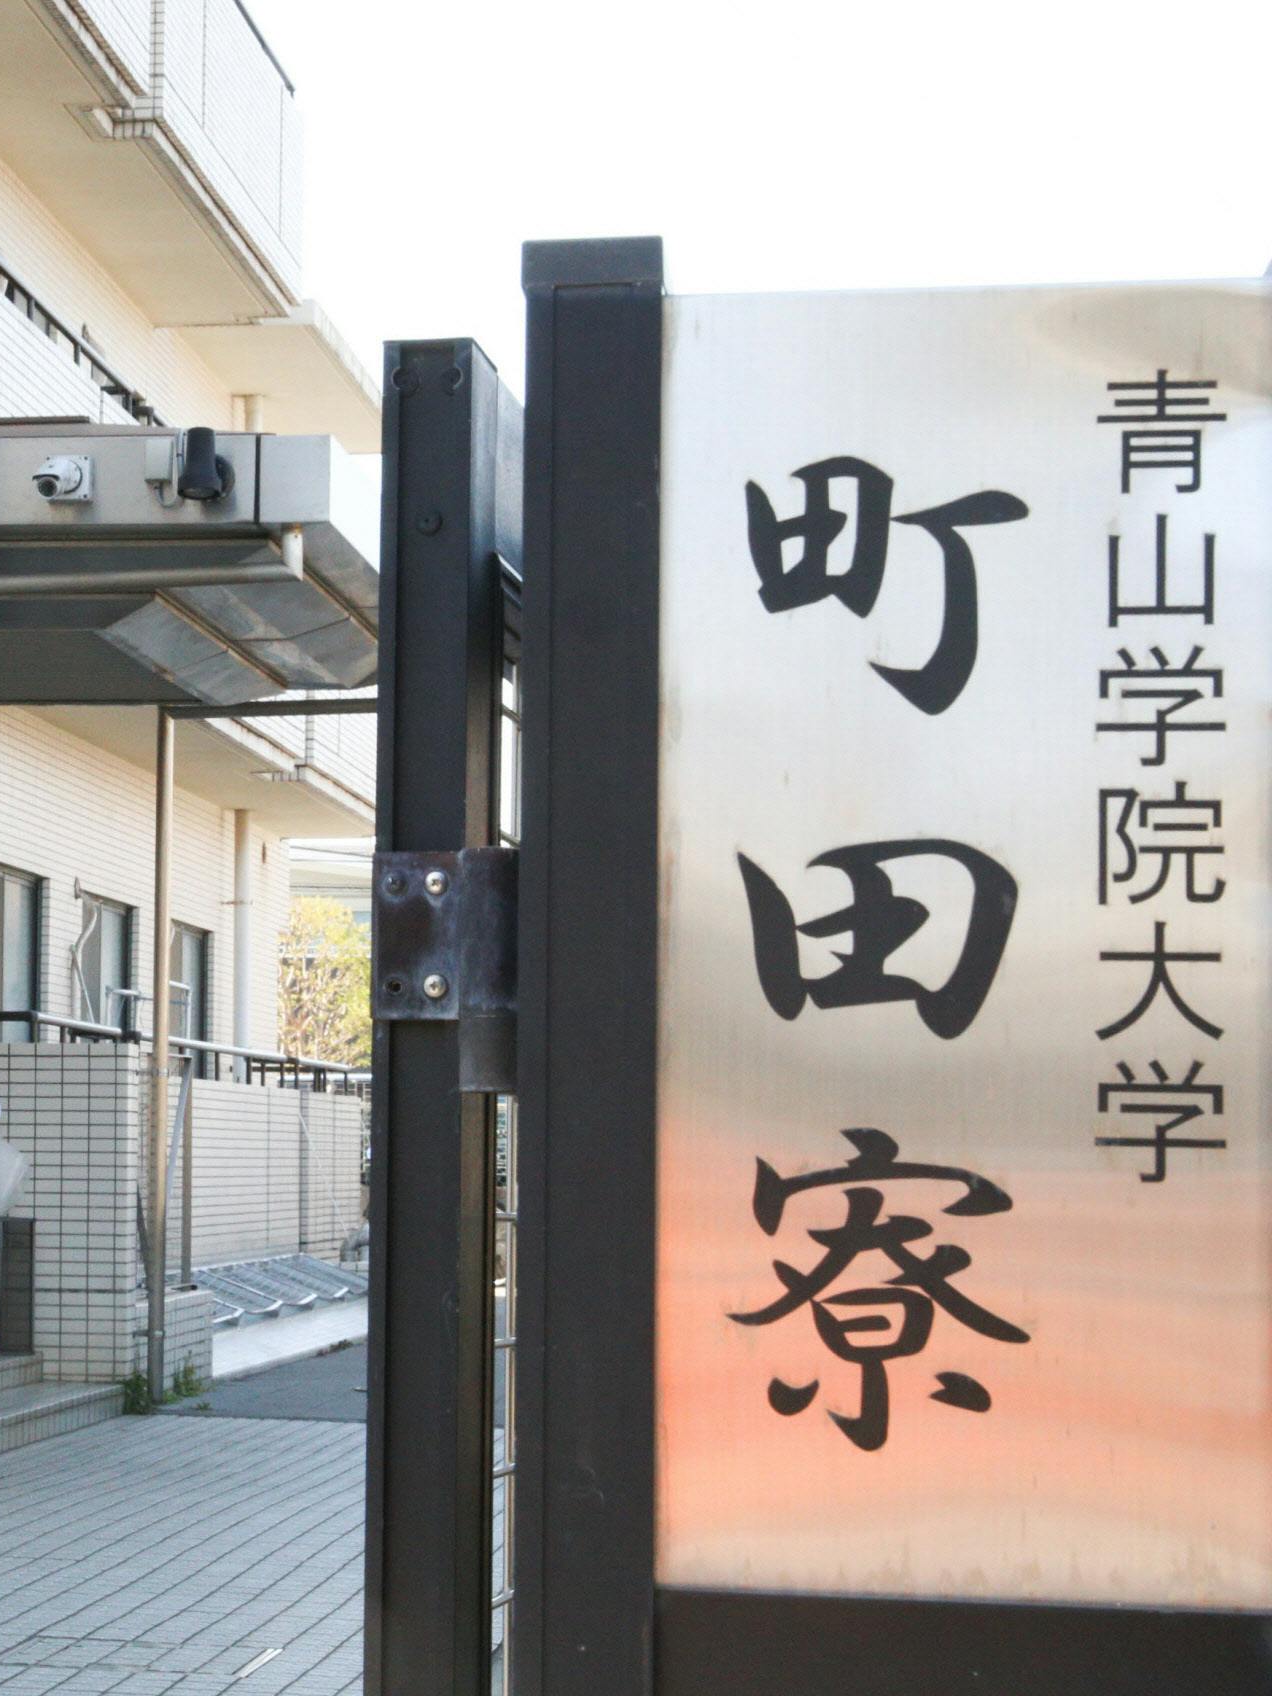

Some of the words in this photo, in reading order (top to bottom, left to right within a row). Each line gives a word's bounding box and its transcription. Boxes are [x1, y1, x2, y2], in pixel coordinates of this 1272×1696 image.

[729, 455, 1030, 1452] 町田寮
[1095, 369, 1227, 1183] 青山学院大学
